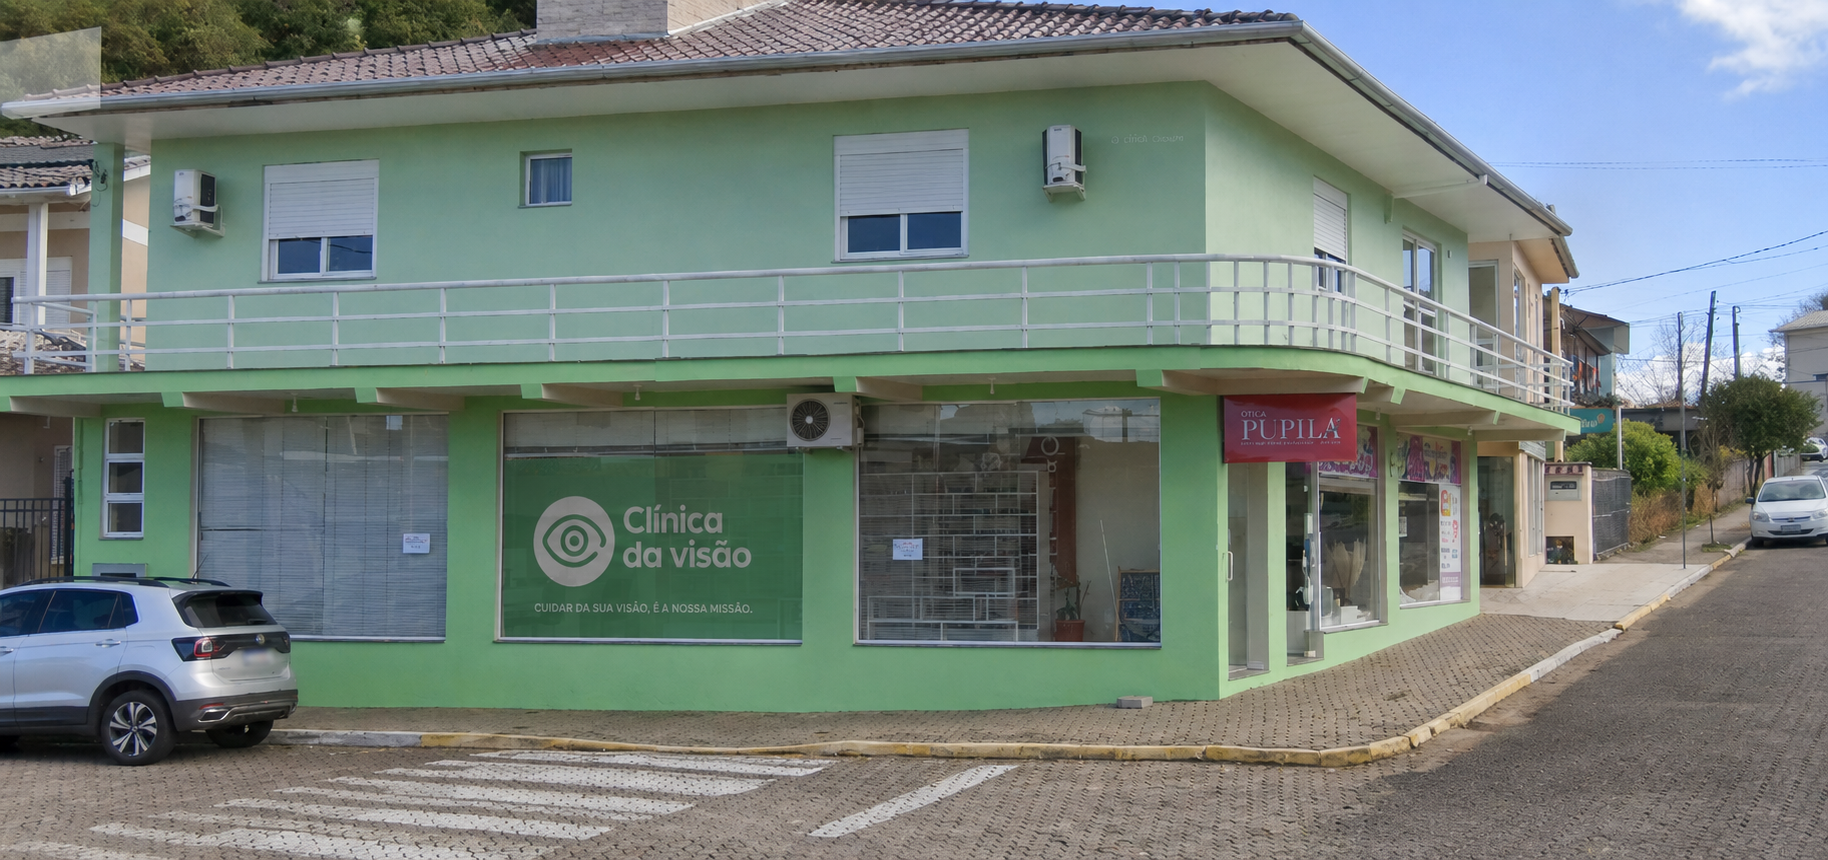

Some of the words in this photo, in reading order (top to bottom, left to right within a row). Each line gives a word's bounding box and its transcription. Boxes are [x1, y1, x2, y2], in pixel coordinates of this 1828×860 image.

[1241, 417, 1341, 441] PUPILA
[623, 504, 723, 534] Clínica
[622, 541, 662, 568] da
[670, 539, 752, 568] visão
[534, 602, 573, 613] CUIDAR
[575, 602, 591, 613] DA
[592, 602, 614, 613] SUA
[615, 600, 651, 615] VISÃO,
[661, 603, 669, 613] A
[671, 603, 708, 614] NOSSA
[709, 602, 753, 614] MISSÃO.
